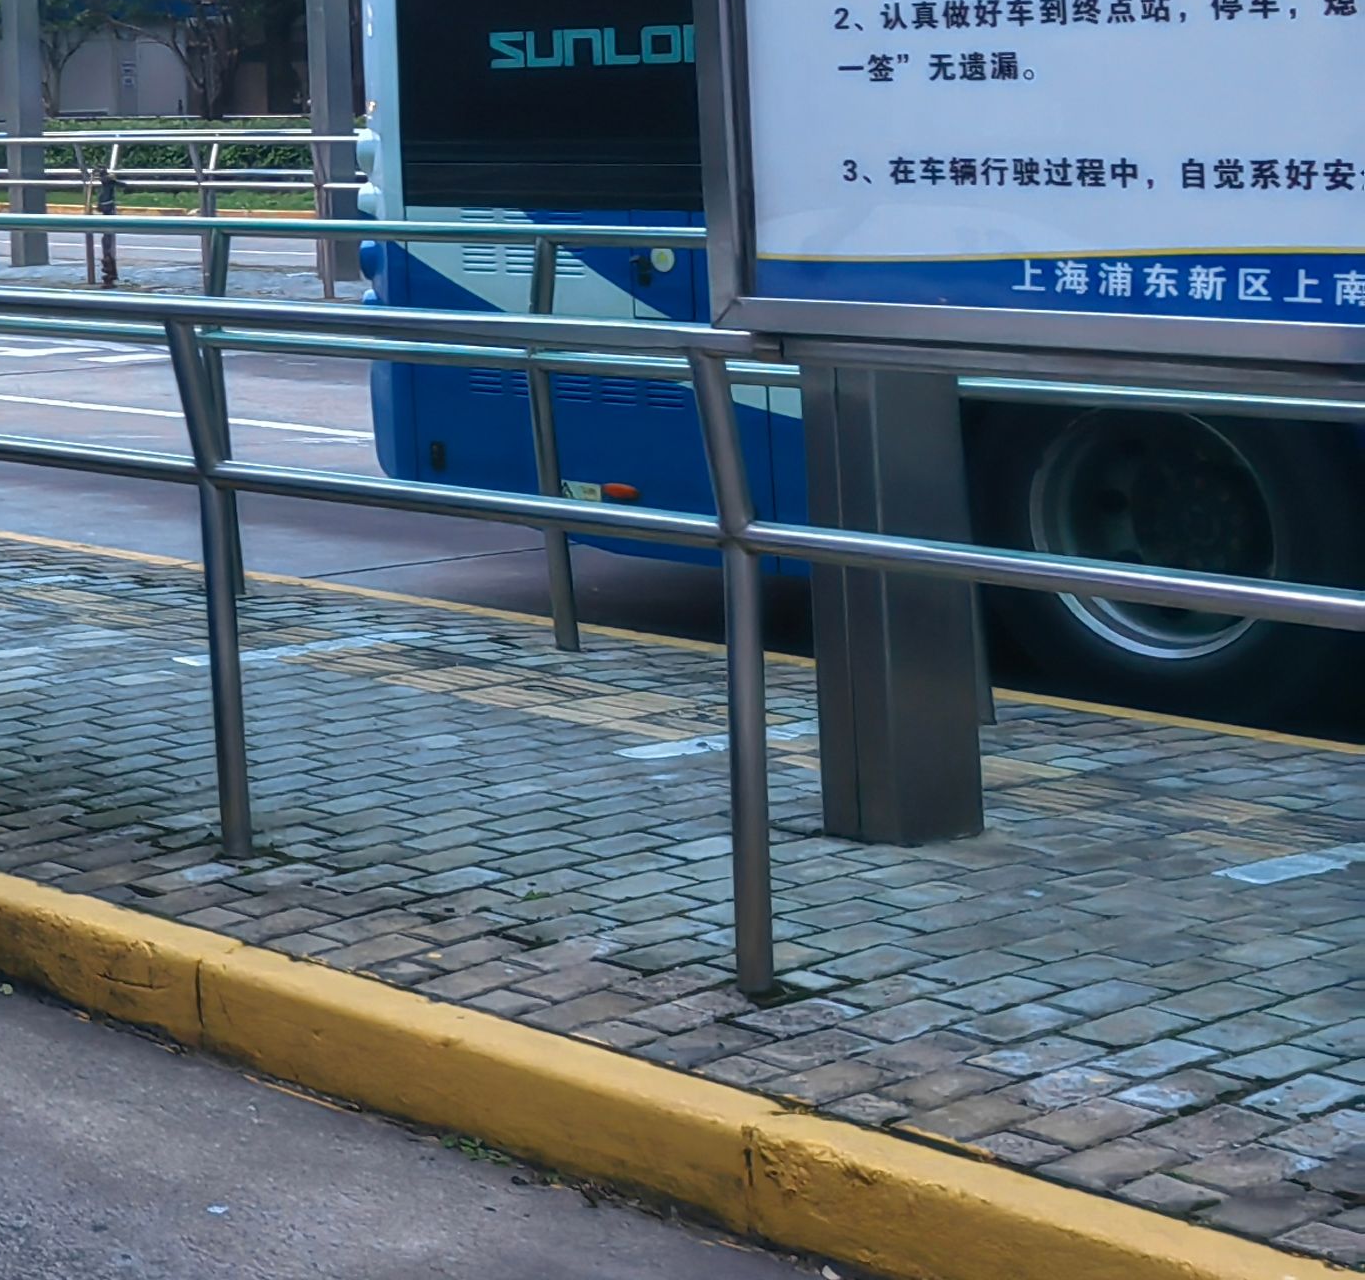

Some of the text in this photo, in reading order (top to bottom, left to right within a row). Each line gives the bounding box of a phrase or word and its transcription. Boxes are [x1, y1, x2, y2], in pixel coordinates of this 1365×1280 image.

[842, 156, 1365, 191] 3、在车辆行驶过程中，自觉系好安
[1011, 259, 1365, 307] 上海浦东新区上南
